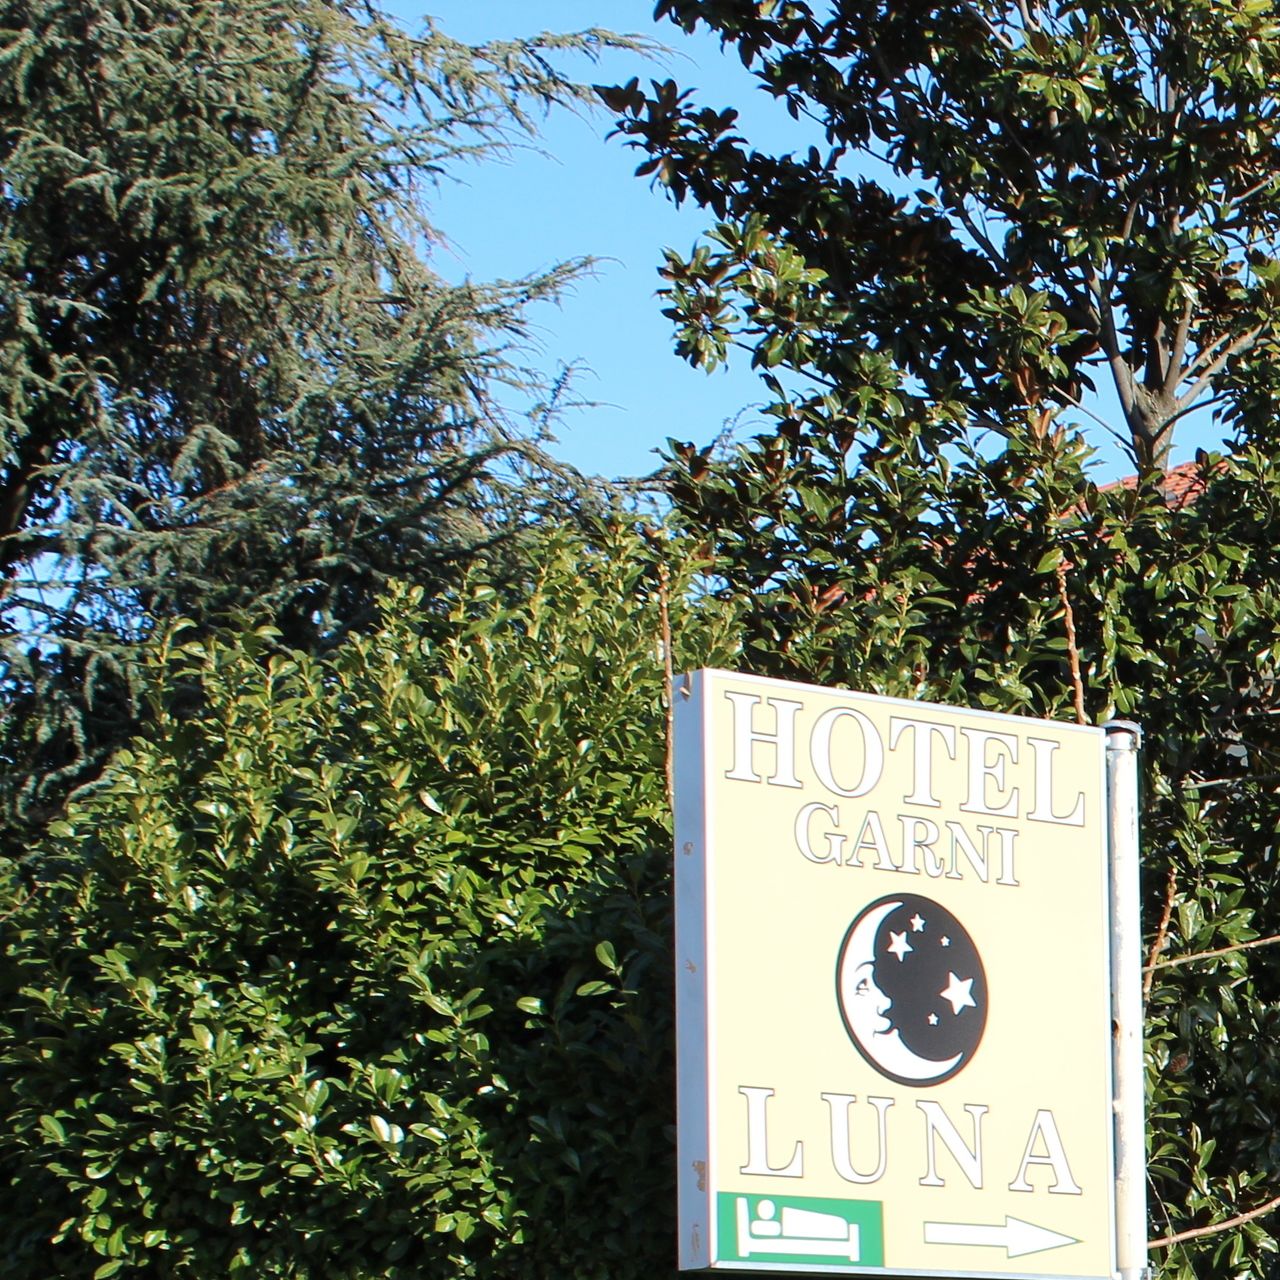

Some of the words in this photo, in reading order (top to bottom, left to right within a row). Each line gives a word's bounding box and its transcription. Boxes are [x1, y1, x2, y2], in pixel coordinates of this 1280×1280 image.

[724, 691, 1085, 827] HOTEL
[794, 801, 1020, 887] GARNI
[737, 1085, 1083, 1196] LUNA
